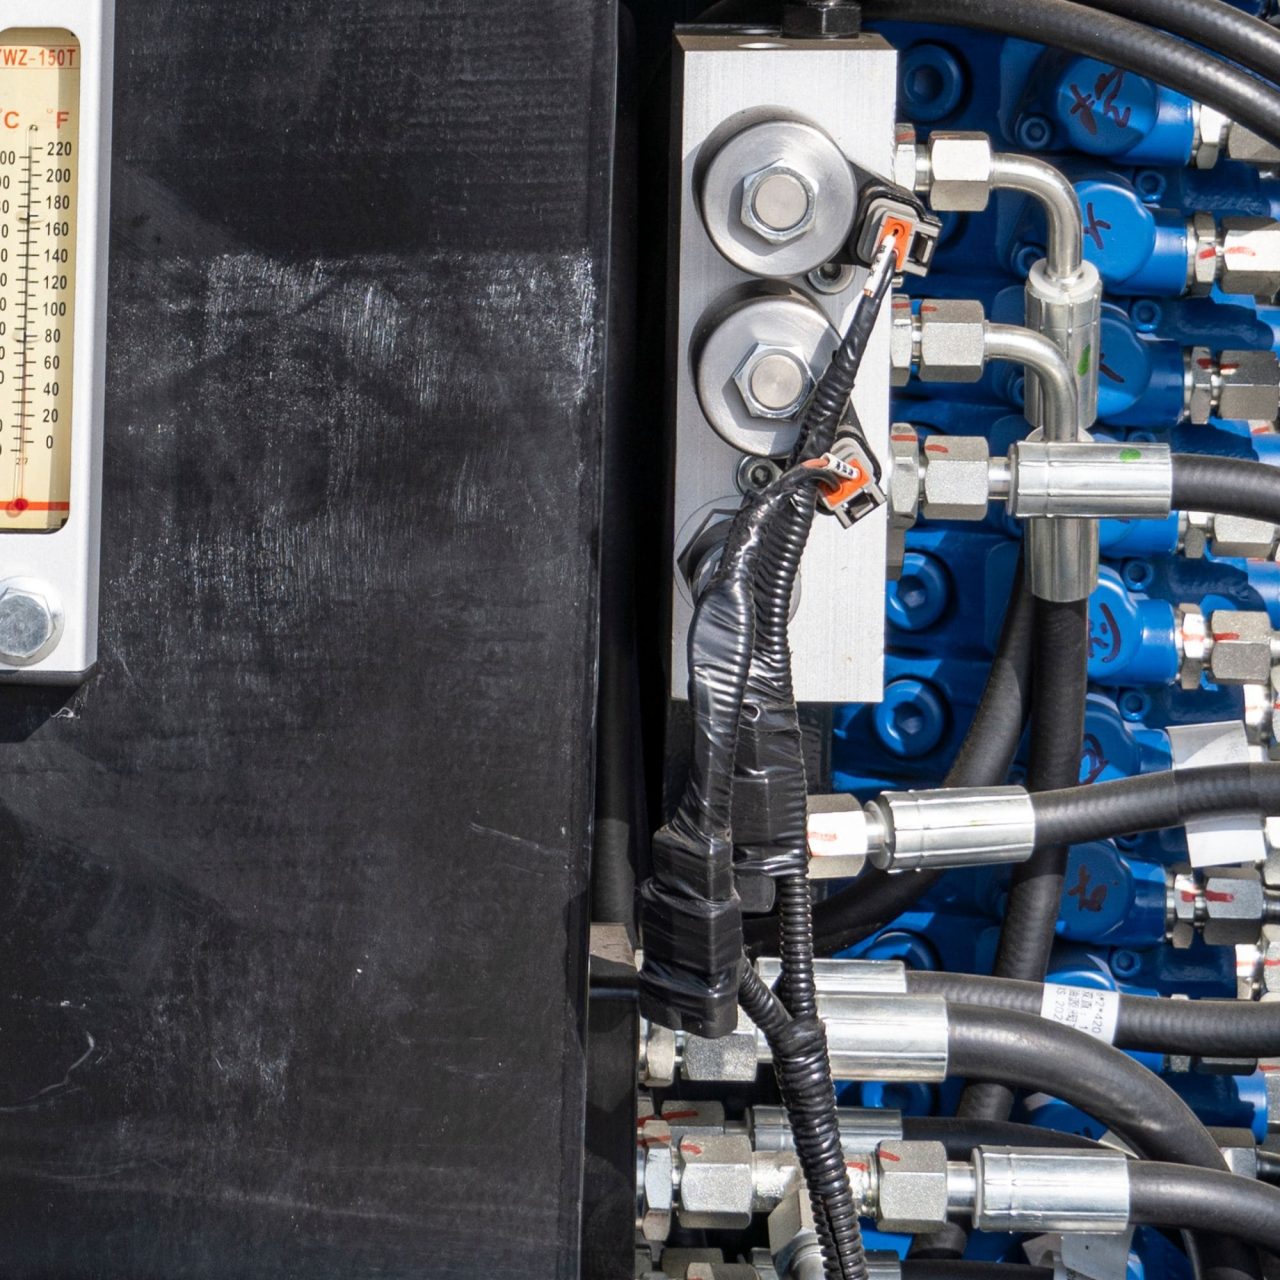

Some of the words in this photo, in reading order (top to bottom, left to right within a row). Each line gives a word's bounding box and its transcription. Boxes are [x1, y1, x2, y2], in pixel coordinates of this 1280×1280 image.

[47, 141, 72, 156] 220
[46, 168, 71, 183] 200
[46, 195, 70, 210] 180
[45, 222, 69, 236] 160
[45, 248, 68, 263] 140
[44, 275, 67, 290] 120
[43, 302, 67, 316] 100
[45, 328, 61, 343] 80
[44, 355, 60, 370] 60
[43, 382, 59, 396] 40
[43, 408, 58, 423] 20
[46, 435, 53, 449] 0
